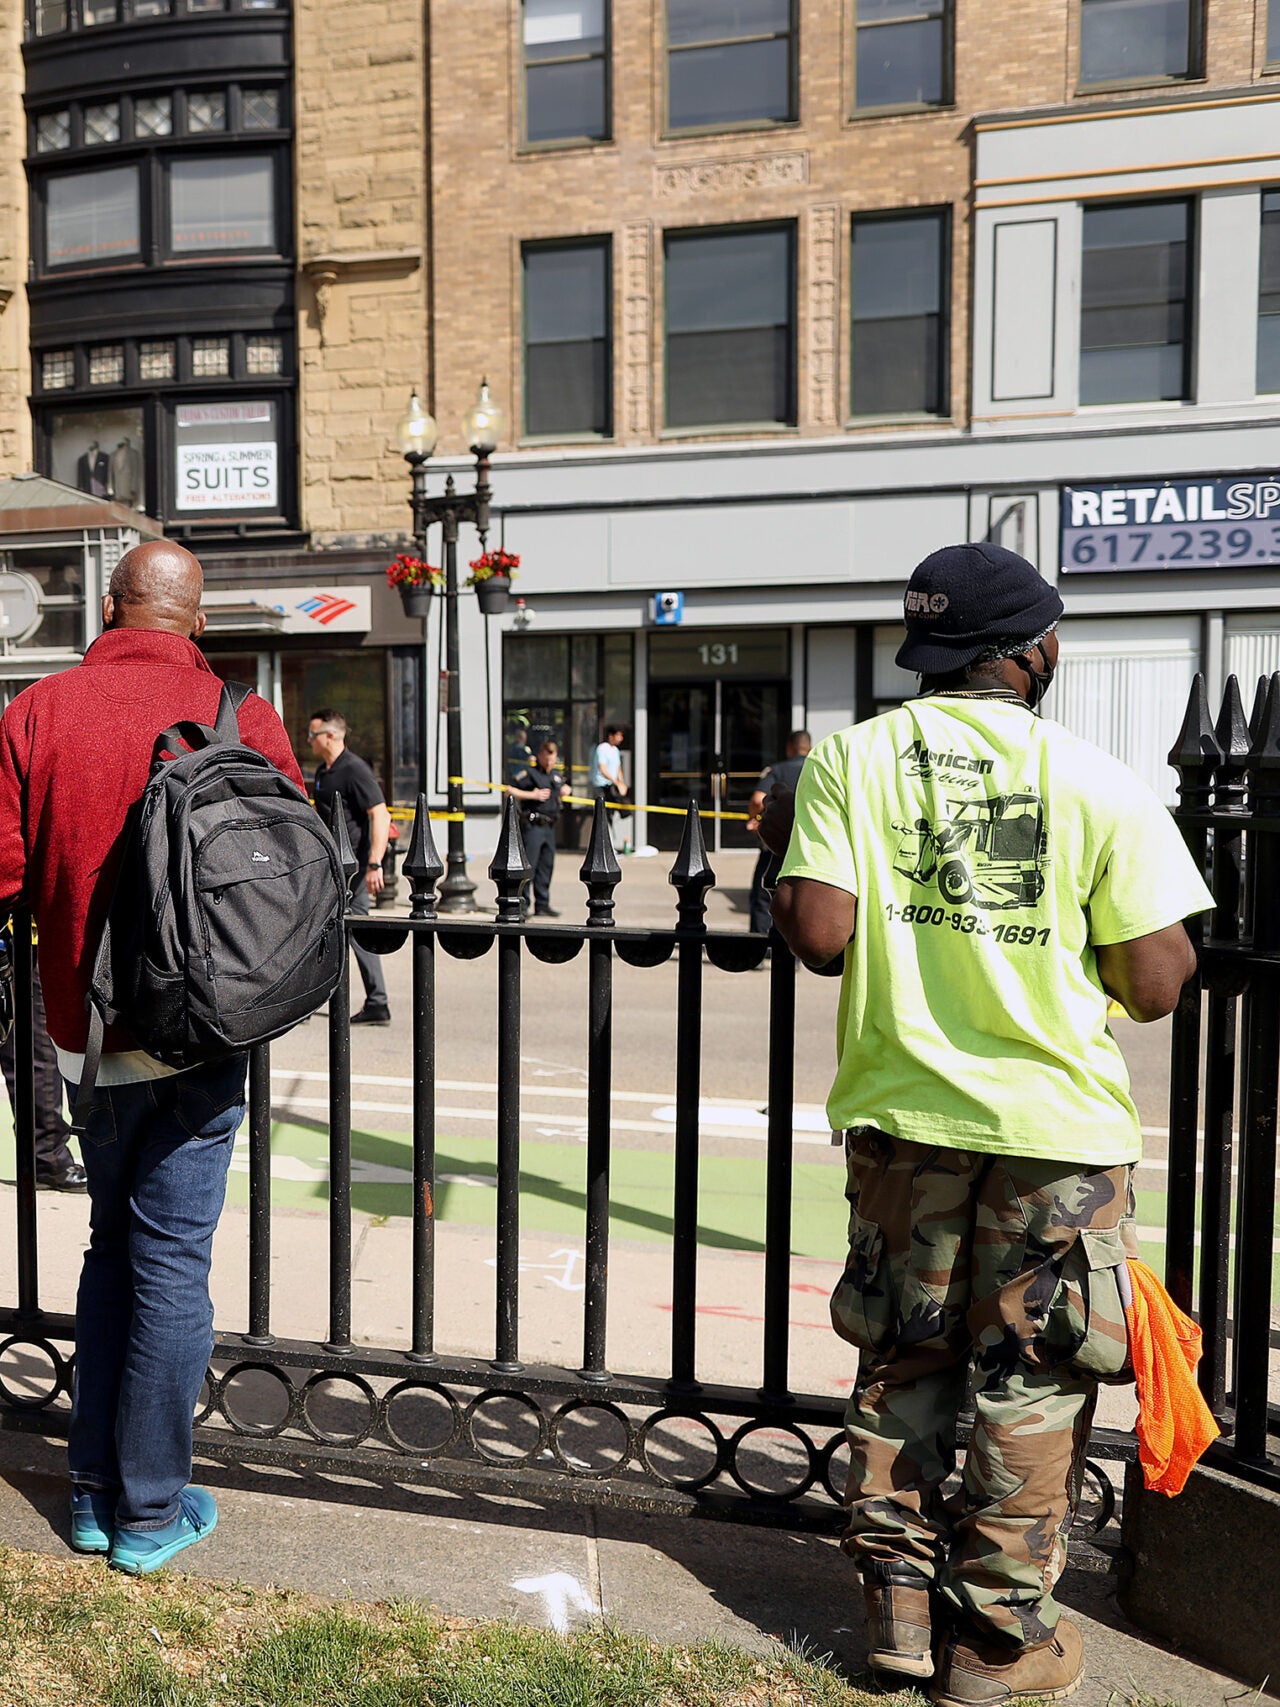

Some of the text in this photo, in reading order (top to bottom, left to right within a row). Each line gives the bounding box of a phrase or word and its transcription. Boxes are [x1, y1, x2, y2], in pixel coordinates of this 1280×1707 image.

[184, 451, 219, 464] SPRING
[228, 449, 272, 462] SUMMER
[186, 466, 270, 489] SUITS
[185, 493, 207, 503] FREE
[698, 643, 739, 665] 131
[885, 903, 1051, 947] 1-800-931691
